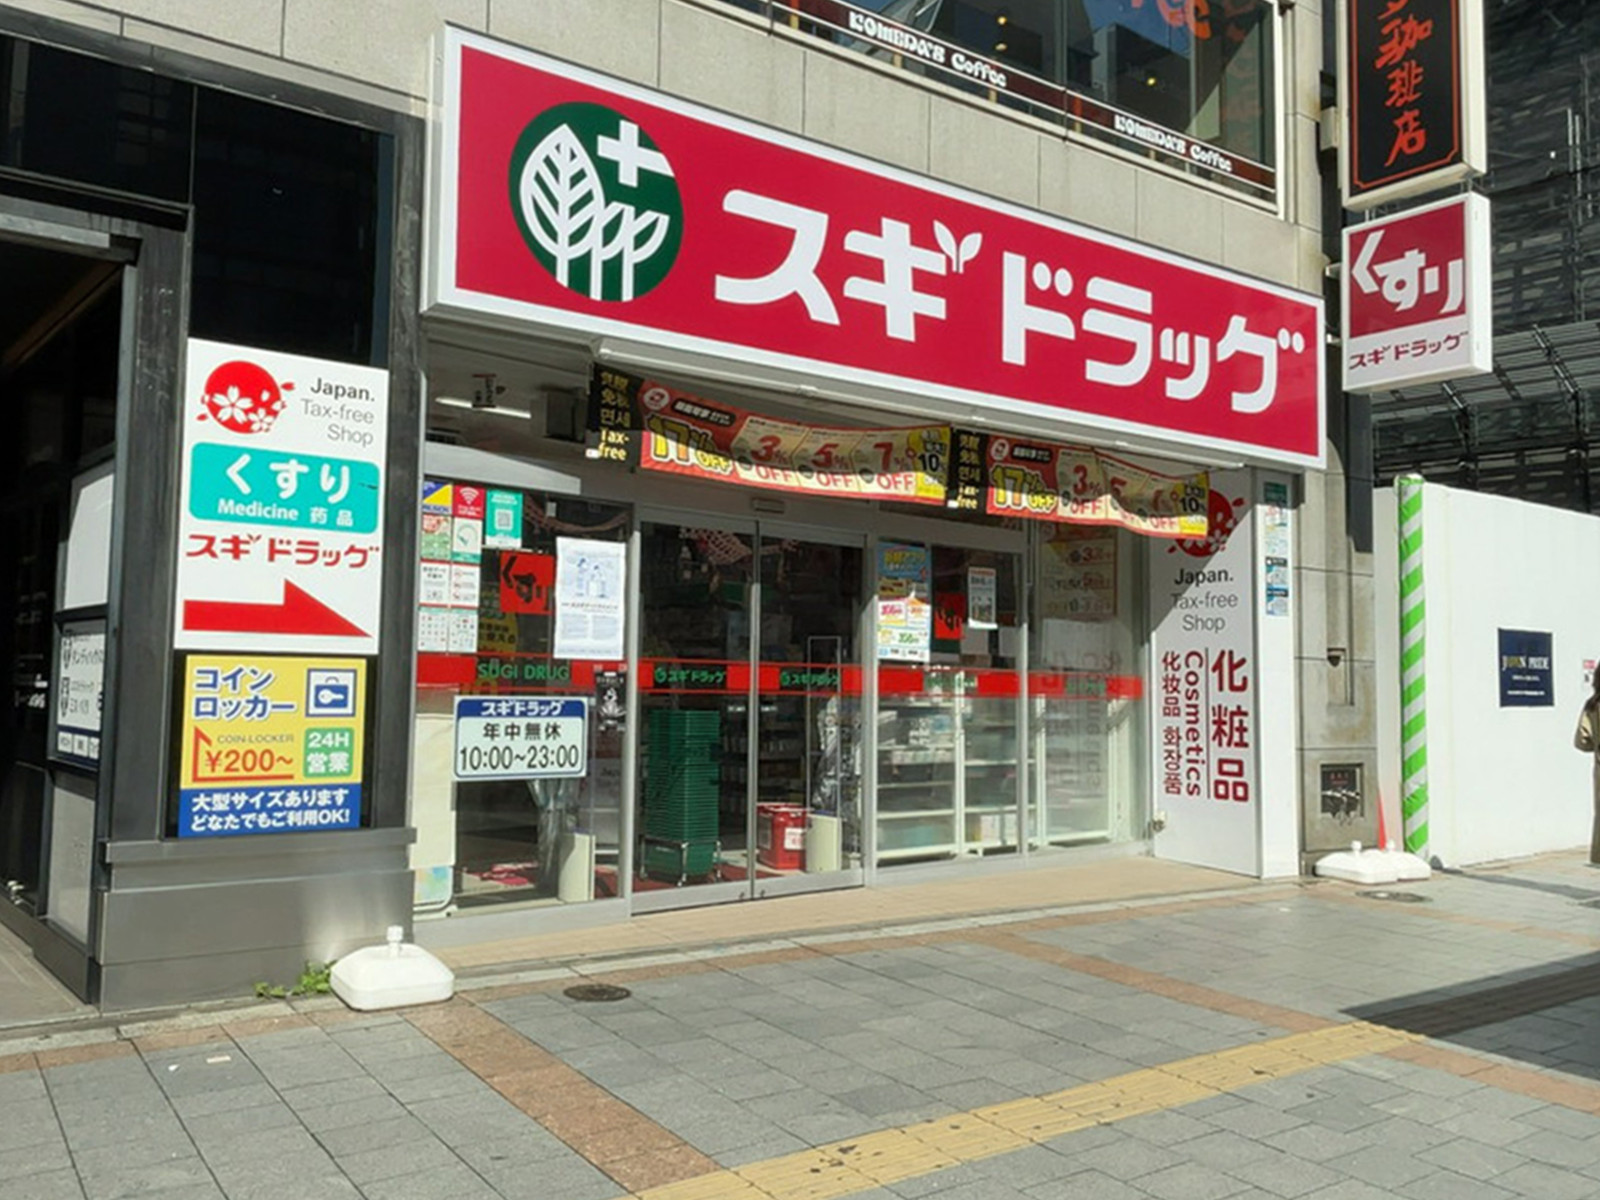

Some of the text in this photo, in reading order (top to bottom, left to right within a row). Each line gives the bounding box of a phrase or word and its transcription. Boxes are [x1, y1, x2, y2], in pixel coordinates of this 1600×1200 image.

[951, 53, 1007, 88] Coffee
[1375, 0, 1433, 167] 珈琲店
[1190, 145, 1232, 172] Coffee
[1351, 229, 1465, 315] くすり
[714, 188, 1305, 414] スギドラッグ
[1348, 330, 1469, 370] スギドラッグ
[311, 378, 375, 402] Japan.
[301, 398, 375, 424] Tax-free
[327, 425, 373, 447] Shop
[598, 442, 627, 461] free
[226, 454, 350, 504] くすり
[756, 464, 793, 483] OFF
[816, 471, 853, 488] OFF
[877, 472, 915, 490] OFF
[218, 499, 299, 521] Medicine
[1071, 498, 1102, 515] OFF
[186, 534, 380, 569] スギドラッグ
[1174, 568, 1234, 588] Japan.
[1171, 591, 1239, 610] Tax-free
[1182, 614, 1226, 634] Shop
[194, 666, 274, 691] コイン
[478, 663, 570, 681] SUGI DRUG
[194, 695, 295, 719] ロッカー
[481, 700, 565, 716] スギドラッグ
[483, 722, 562, 740] 年中無休
[1184, 650, 1207, 797] Cosmetics
[1211, 649, 1250, 803] 化粧品
[217, 734, 294, 744] COIN LOCKER
[308, 731, 350, 748] 24H
[306, 751, 350, 774] 営業
[192, 788, 349, 812] 大型サイズあります
